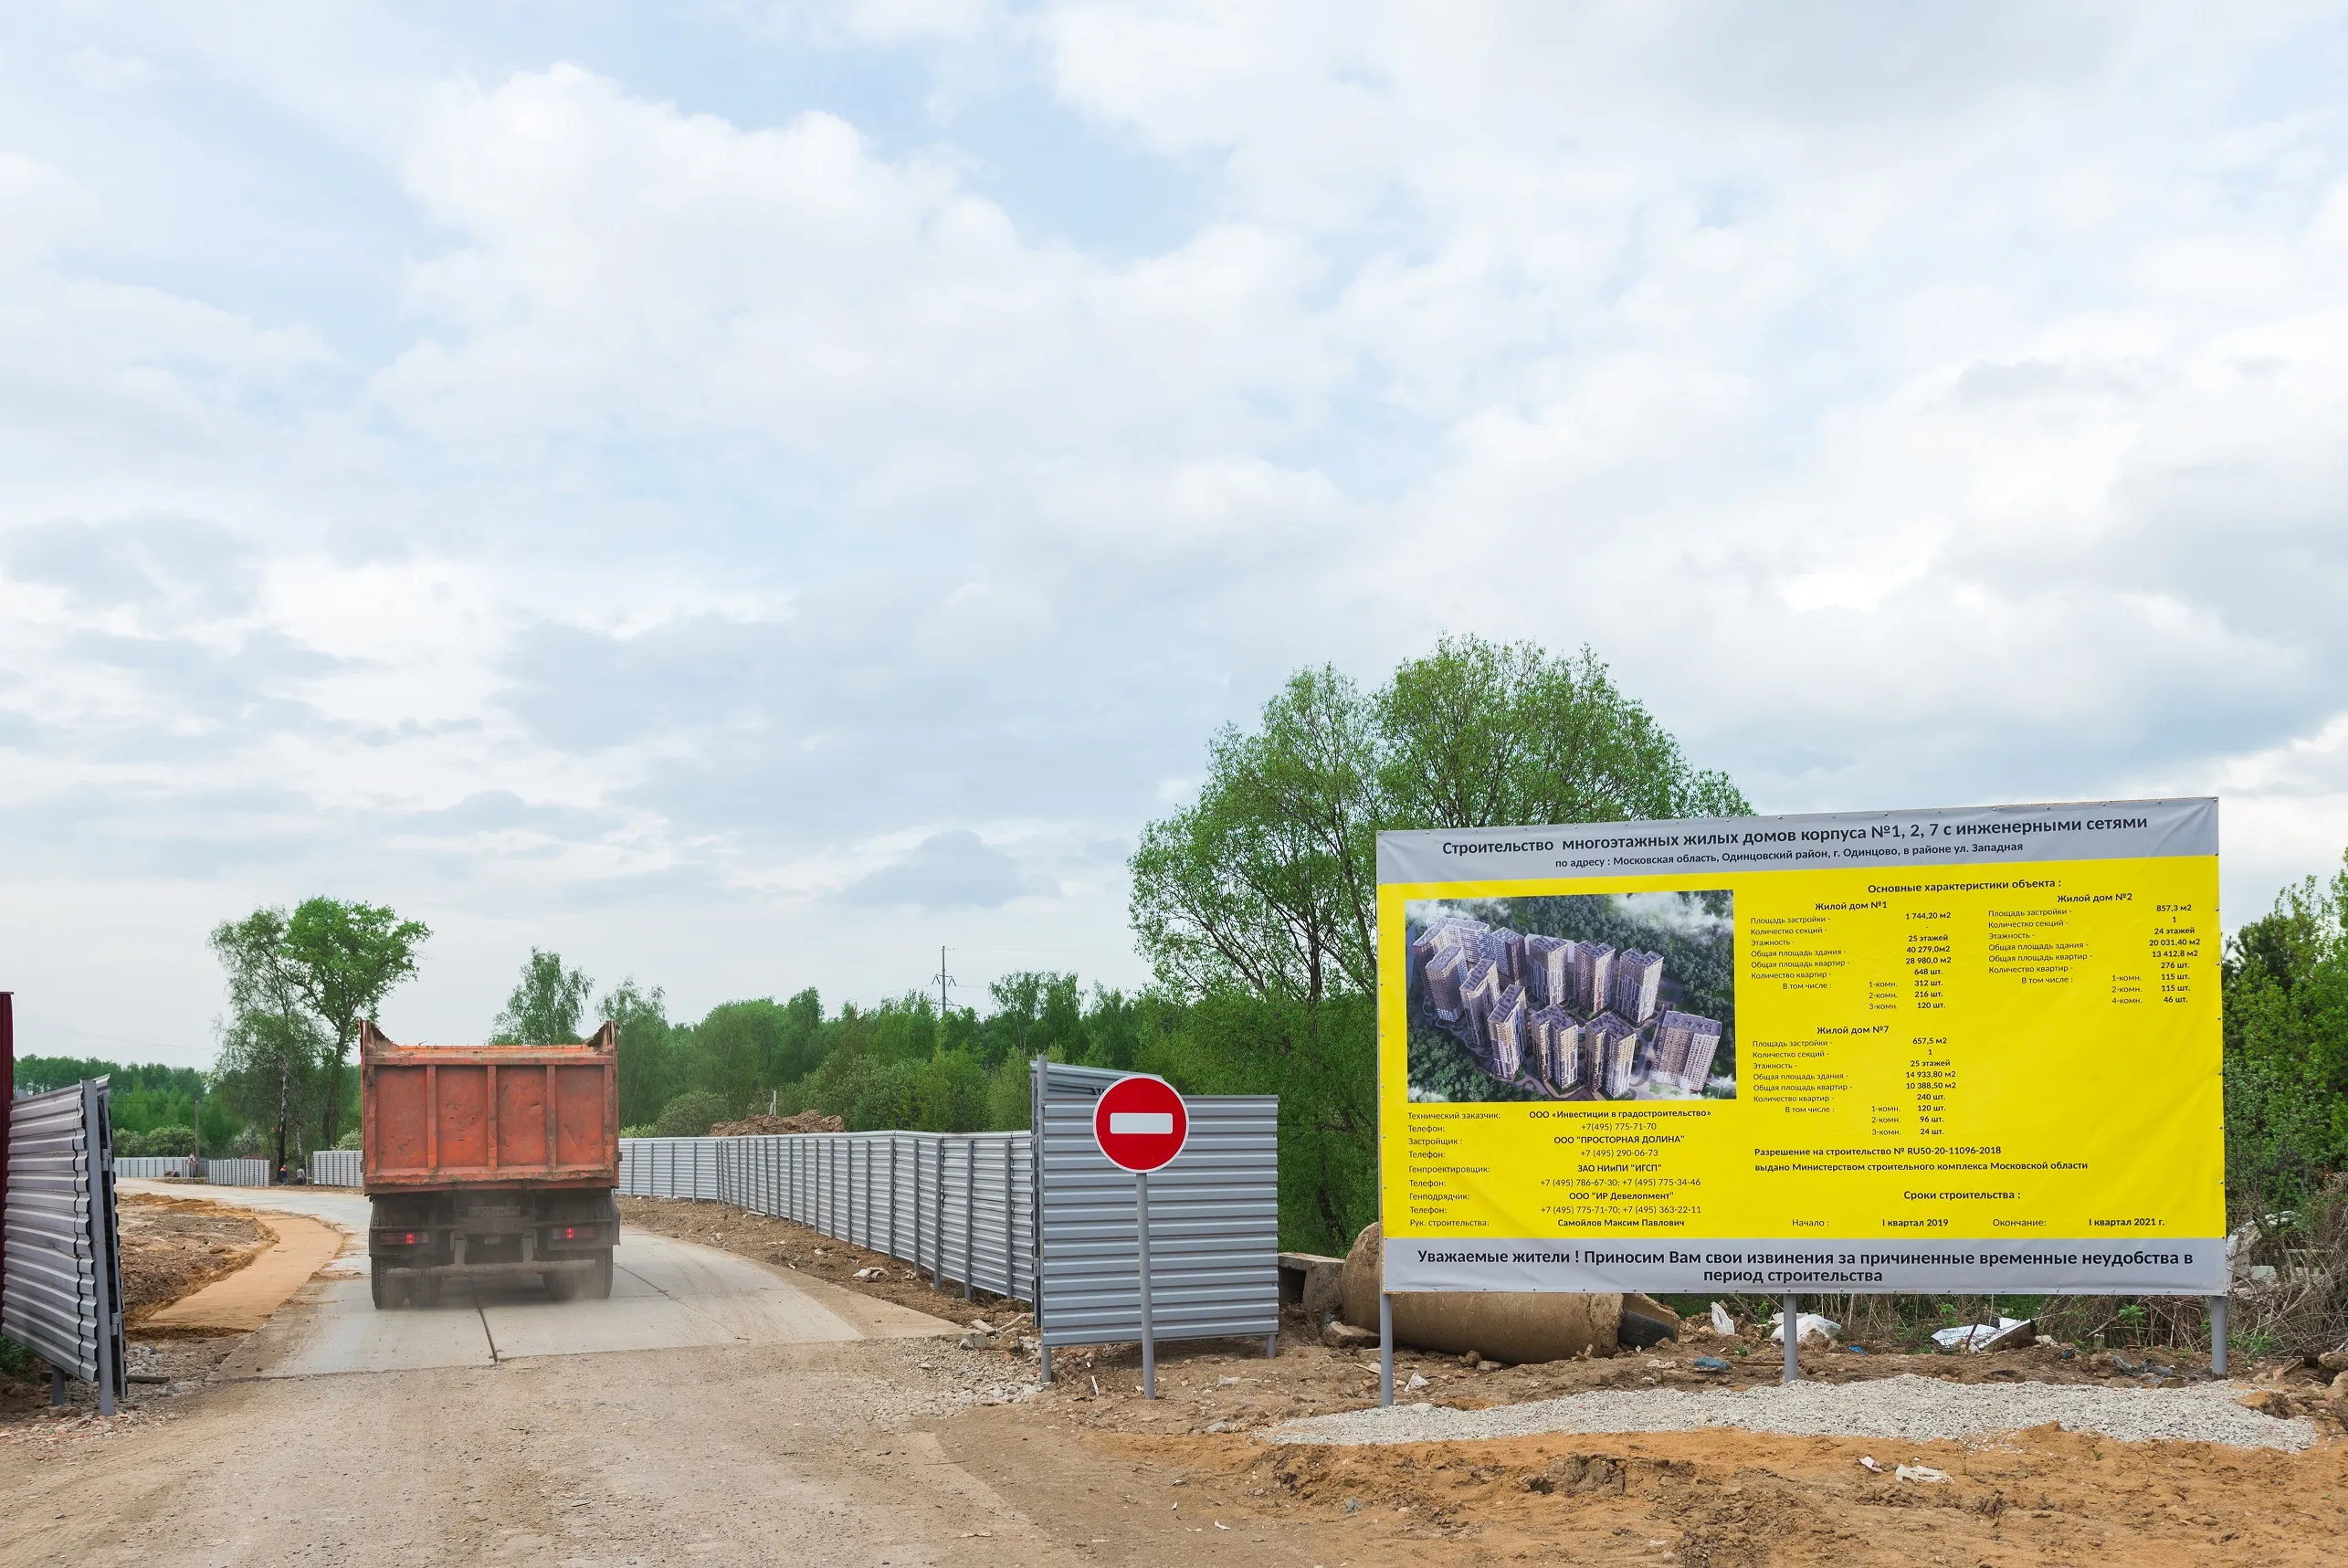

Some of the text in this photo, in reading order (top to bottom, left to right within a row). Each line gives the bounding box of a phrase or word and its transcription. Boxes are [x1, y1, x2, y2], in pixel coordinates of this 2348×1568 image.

[1442, 817, 2147, 857] Строительство многоэтажных жилых домов корпуса №1, 2, 7 с инженерными сетями
[1570, 858, 1605, 868] адресу
[1613, 856, 1674, 866] Московская
[1676, 853, 1719, 863] область,
[1722, 849, 1793, 863] Одинцовский
[1795, 848, 1830, 860] район,
[1842, 847, 1901, 858] Одинцово,
[1911, 845, 1951, 856] районе
[1953, 845, 1969, 856] ул.
[1972, 843, 2023, 854] Западная
[1868, 879, 2055, 893] Основные характеристики объекта
[2057, 892, 2132, 903] Жилой дом №2
[1815, 900, 1887, 910] Жилой дом №1
[2155, 904, 2178, 912] 857,3
[1786, 915, 1826, 924] застройки
[1795, 926, 1822, 935] секций
[2165, 926, 2195, 934] этажей
[1919, 933, 1948, 942] этажей
[2160, 938, 2187, 946] 031,40
[1750, 950, 1776, 958] Общая
[1814, 949, 1841, 957] здания
[2163, 949, 2185, 957] 412,8
[1751, 961, 1776, 969] Общая
[1816, 1026, 1848, 1034] Жилой
[1872, 1025, 1889, 1033] №7
[1912, 1037, 1933, 1045] 657,5
[1916, 1070, 1943, 1079] 933,80
[1917, 1081, 1943, 1089] 388,50
[1407, 1111, 1459, 1120] Технический
[1552, 1110, 1608, 1119] «Инвестиции
[1617, 1110, 1711, 1119] градостроительство»
[1407, 1124, 1445, 1133] Телефон:
[1581, 1121, 1657, 1131] +7(495) 775-71-70
[1408, 1137, 1458, 1146] Застройщик
[1576, 1135, 1639, 1143] "ПРОСТОРНАЯ
[1641, 1134, 1684, 1144] ДОЛИНА"
[1407, 1150, 1445, 1159] Телефон:
[1580, 1148, 1658, 1158] +7 (495) 290-06-73
[1754, 1148, 1810, 1157] Разрешение
[1826, 1148, 1891, 1156] строительство
[1907, 1145, 2001, 1154] RU50-20-11096-2018
[1408, 1165, 1490, 1174] Генпроектировщик:
[1596, 1163, 1628, 1172] НИиПИ
[1630, 1163, 1661, 1172] "ИГСП"
[1754, 1164, 1790, 1173] выдано
[1792, 1163, 1865, 1172] Министерством
[1867, 1163, 1934, 1172] строительного
[1990, 1161, 2048, 1170] Московской
[2049, 1161, 2088, 1169] области
[1408, 1179, 1446, 1188] Телефон:
[1540, 1178, 1550, 1186] +7
[1552, 1178, 1573, 1187] (495)
[1575, 1178, 1619, 1187] 786-67-30;
[1621, 1178, 1632, 1186] +7
[1634, 1177, 1656, 1187] (495)
[1409, 1192, 1469, 1202] Генподрядчик:
[1609, 1191, 1673, 1201] Девелопмент"
[1903, 1190, 2015, 1201] Сроки строительства
[1409, 1205, 1447, 1215] Телефон:
[1553, 1205, 1574, 1215] (495)
[1576, 1205, 1620, 1214] 775-71-70;
[1635, 1205, 1657, 1215] (495)
[1658, 1205, 1700, 1214] 363-22-11
[1409, 1218, 1426, 1227] Рук.
[1557, 1218, 1684, 1226] Самойлов Максим Павлович
[1792, 1218, 1825, 1226] Начало
[1926, 1218, 1948, 1226] 2019
[1992, 1218, 2046, 1226] Окончание:
[2093, 1219, 2132, 1227] квартал
[2133, 1217, 2155, 1226] 2021
[1416, 1249, 2193, 1267] Уважаемые жители Приносим Вам свои извинения за причиненные временные неудобства в
[1703, 1270, 1882, 1283] период строительства
